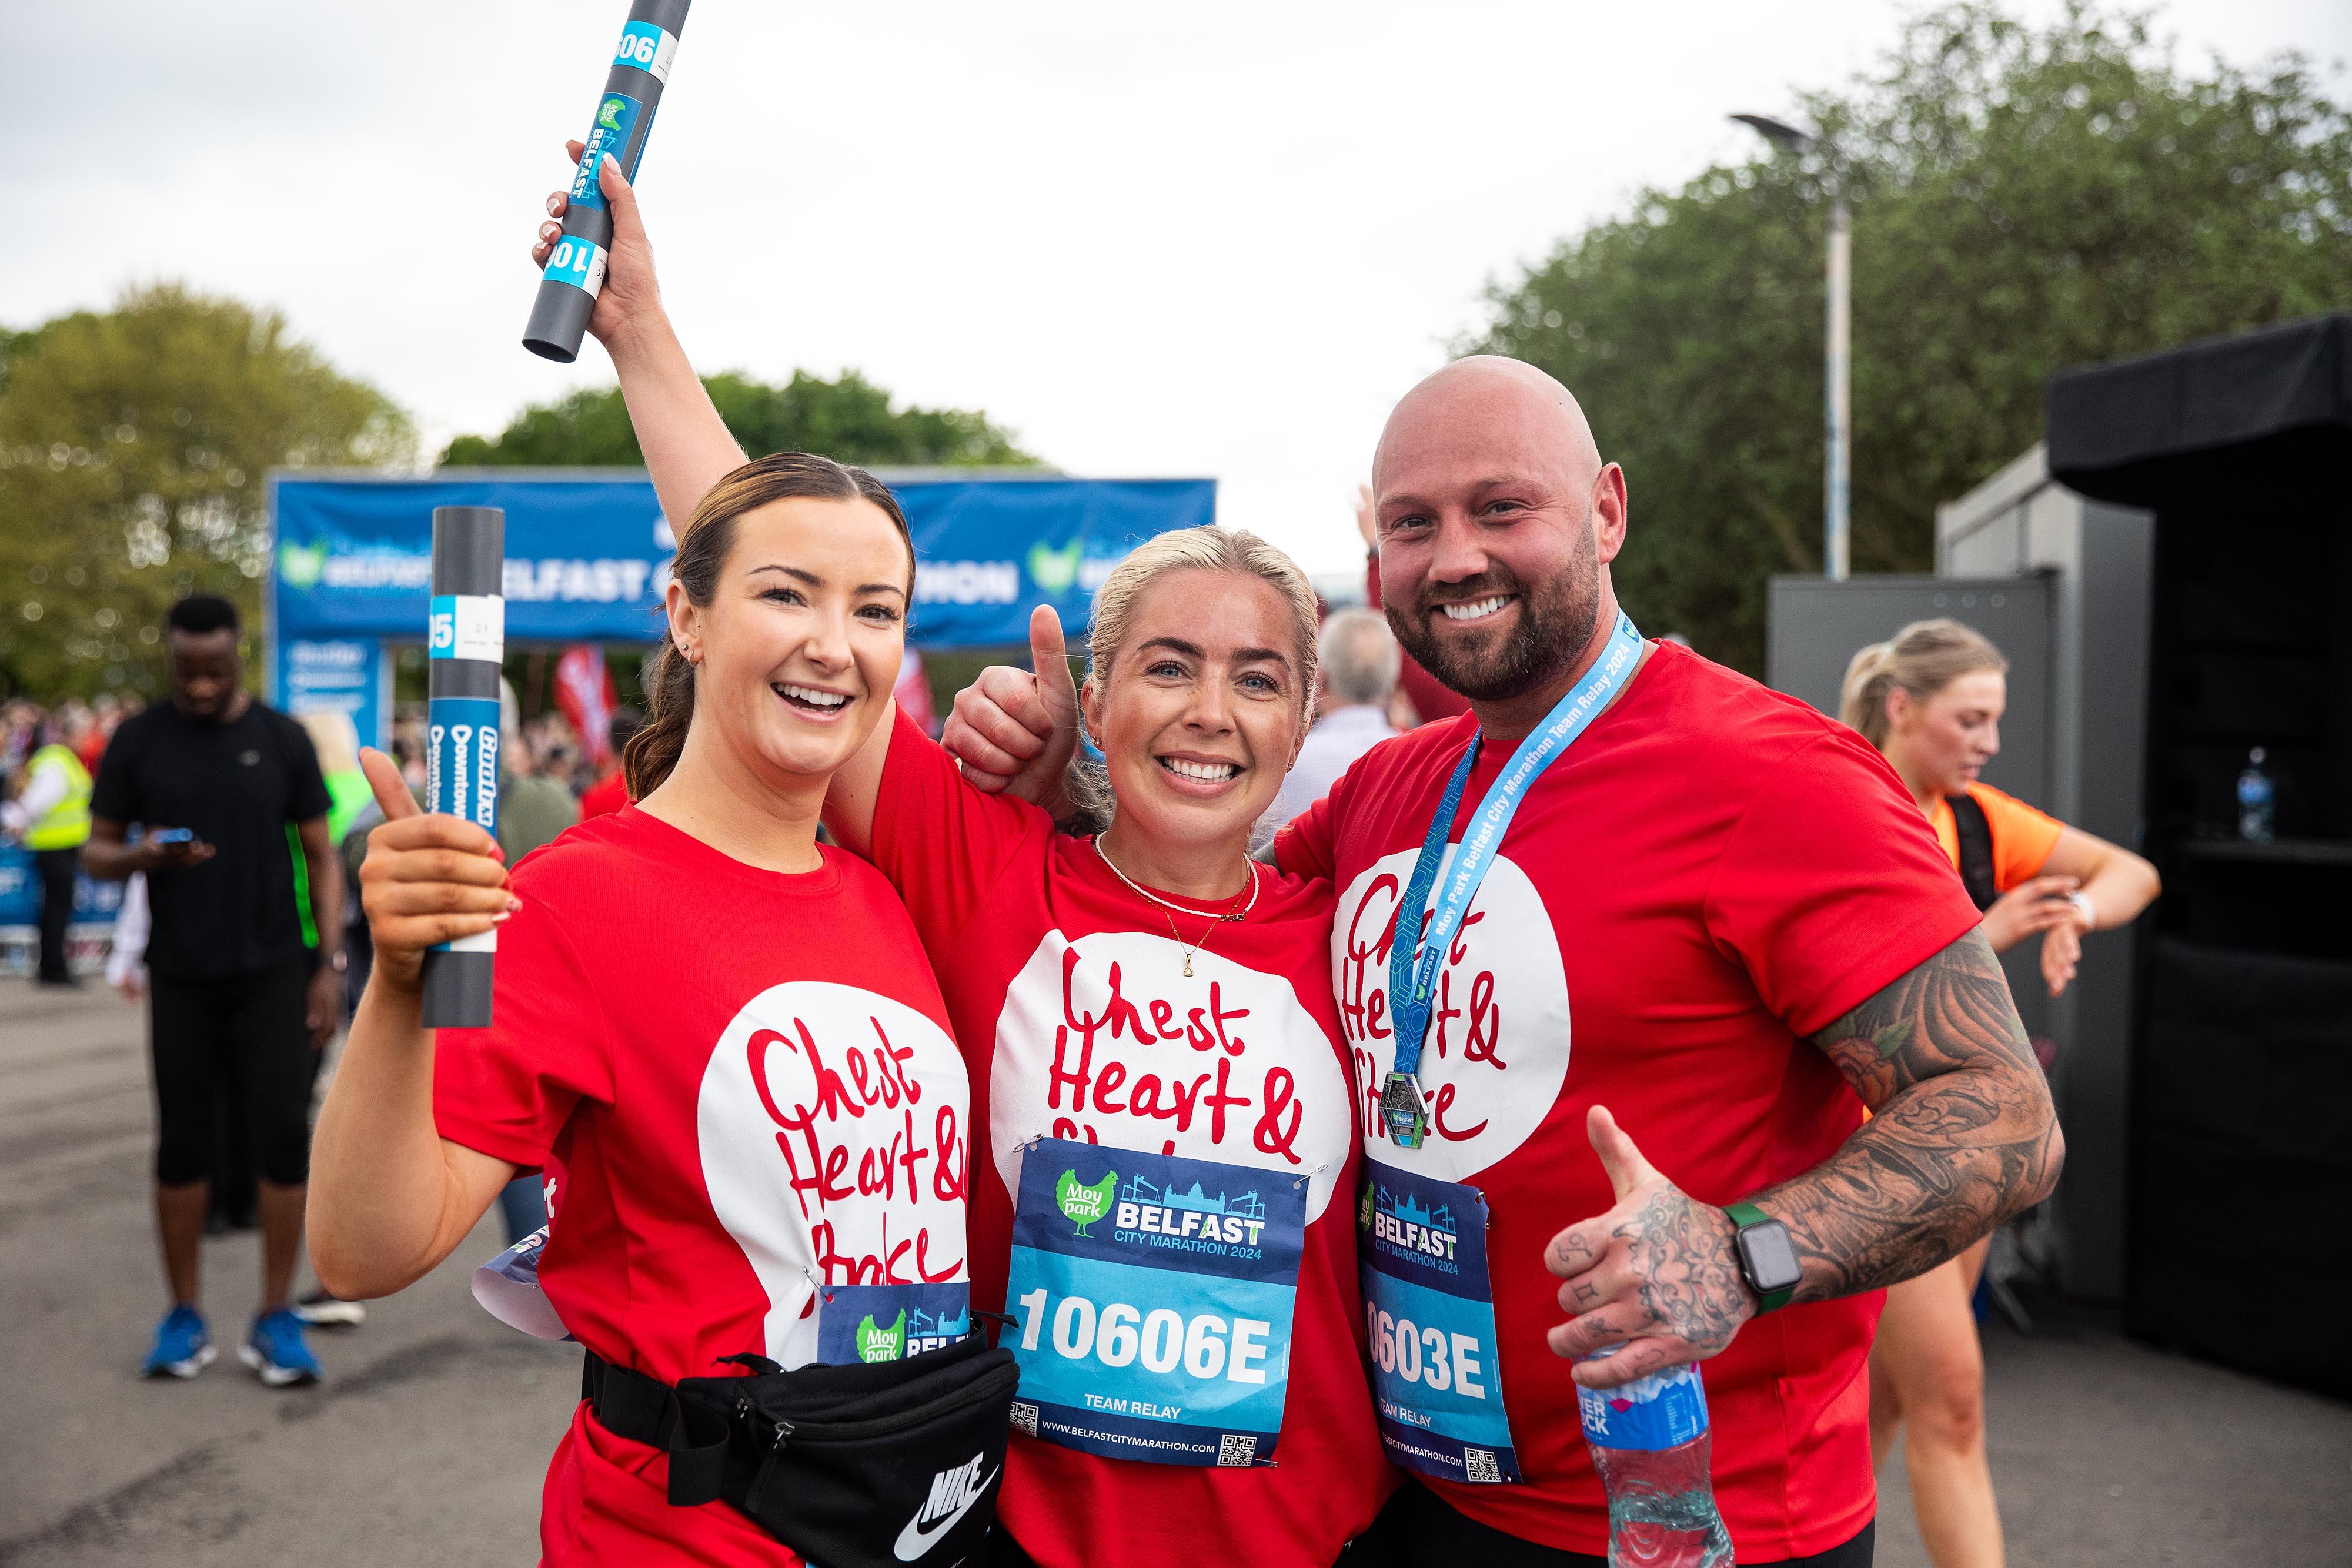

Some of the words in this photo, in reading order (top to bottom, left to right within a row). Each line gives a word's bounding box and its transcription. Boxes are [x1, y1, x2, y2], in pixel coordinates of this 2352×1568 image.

[600, 103, 610, 122] park
[606, 104, 617, 122] Moy
[573, 129, 604, 198] BELFAST
[430, 724, 445, 814] Downtow
[1434, 906, 1456, 937] Moy
[1447, 870, 1471, 904] Park
[1462, 821, 1495, 870] Belfast
[1486, 795, 1510, 823] City
[1503, 737, 1555, 795] Marathon
[1549, 707, 1583, 738] Team
[1576, 674, 1611, 709] Relay
[1606, 642, 1631, 676] 2024
[1423, 950, 1436, 986] BELFAST
[1062, 947, 1250, 1056] Chest
[1342, 941, 1461, 1059] Het
[1464, 971, 1506, 1070] &
[747, 1016, 921, 1131] Chest
[1048, 1011, 1251, 1145] Heart
[1253, 1066, 1303, 1165] &
[776, 1104, 928, 1222] Heart
[934, 1105, 968, 1205] &
[1063, 1200, 1101, 1218] park
[1066, 1183, 1103, 1206] Moy
[1114, 1230, 1147, 1245] CITY
[1150, 1235, 1228, 1256] MARATHON
[1230, 1245, 1262, 1260] 2024
[1115, 1202, 1265, 1246] BELFAST
[1375, 1212, 1456, 1260] BELFAST
[1375, 1239, 1391, 1253] CITY
[1392, 1245, 1435, 1269] MARATHON
[1438, 1259, 1458, 1275] 2024
[866, 1346, 897, 1363] park
[867, 1329, 897, 1348] Moy
[1020, 1288, 1271, 1385] 10606E
[1368, 1300, 1485, 1399] 0603E
[1085, 1393, 1128, 1412] TEAM
[1131, 1402, 1181, 1420] RELAY
[1381, 1398, 1398, 1418] TEAM
[1399, 1407, 1431, 1428] RELAY
[1042, 1420, 1215, 1453] WWW.BELFASTCITYMARATHON.COM
[921, 1451, 984, 1523] NIKE
